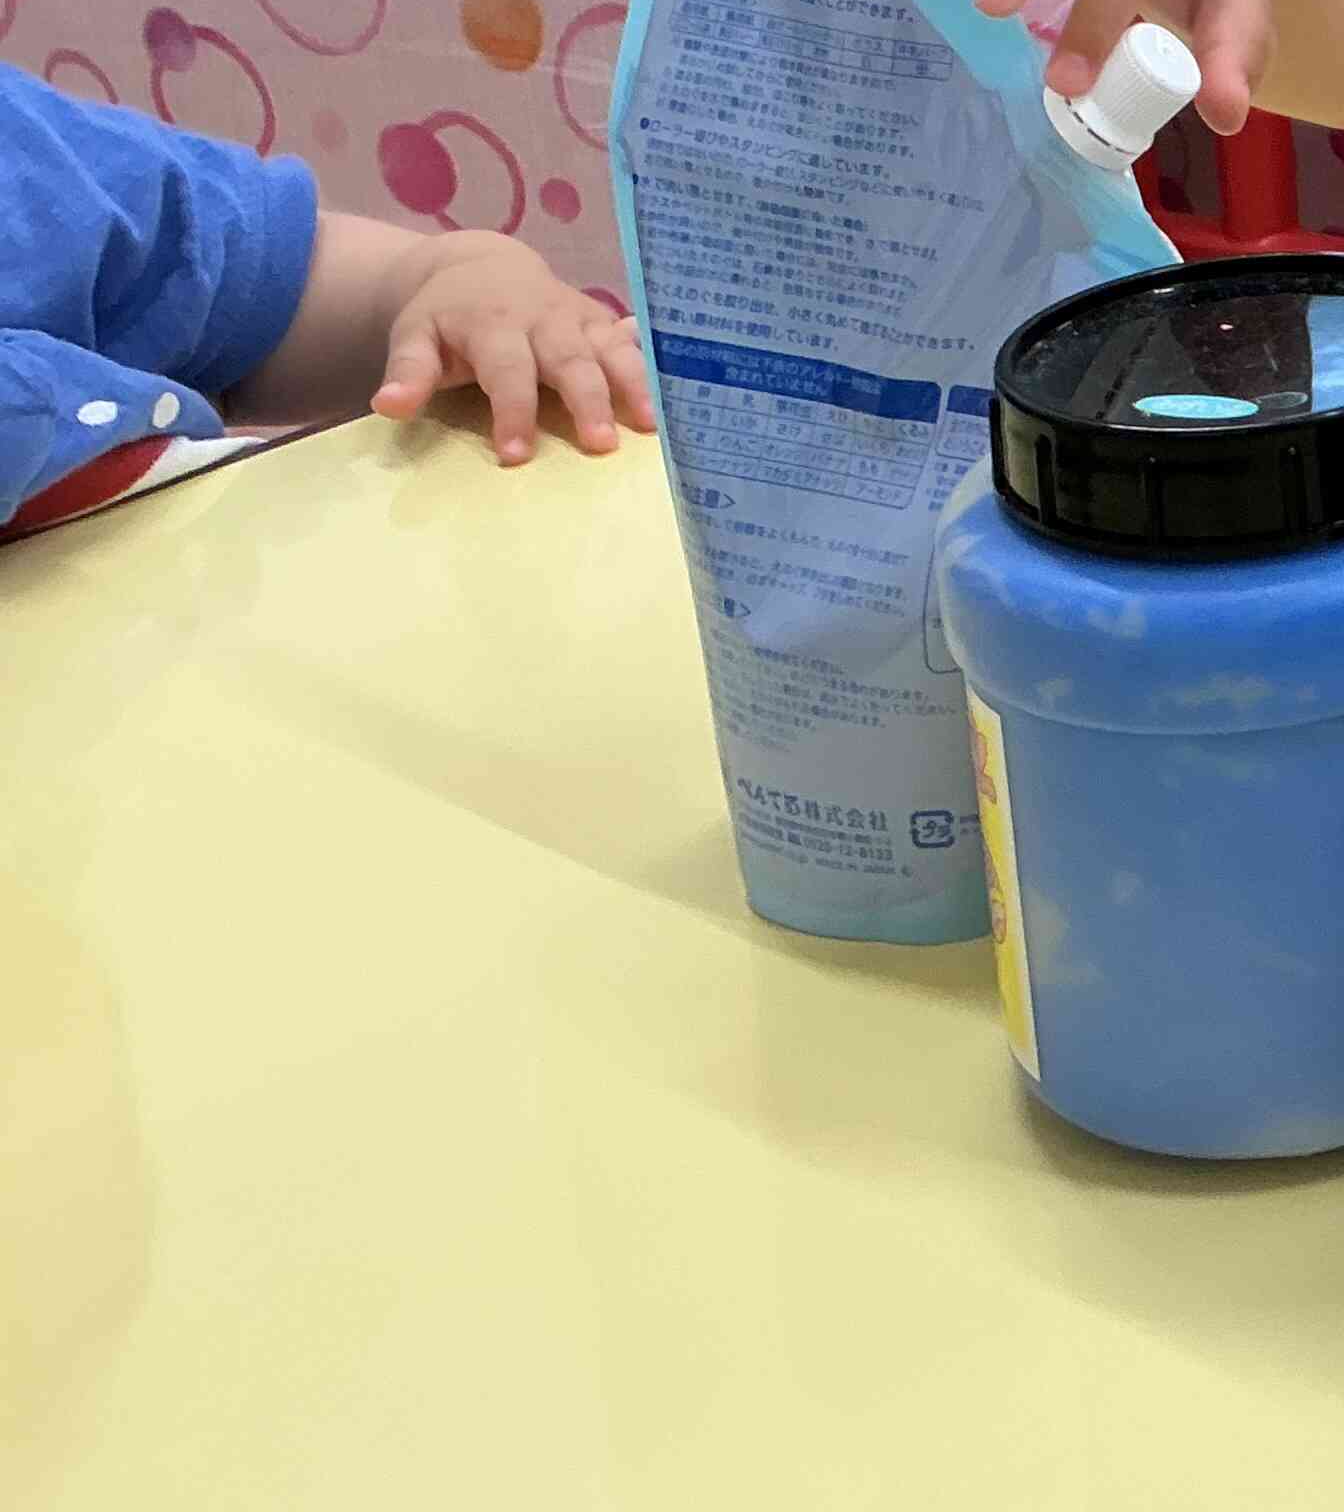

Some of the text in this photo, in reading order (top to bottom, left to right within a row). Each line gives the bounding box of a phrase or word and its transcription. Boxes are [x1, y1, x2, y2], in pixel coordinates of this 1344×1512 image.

[736, 777, 888, 832] ぺんてる株式会社
